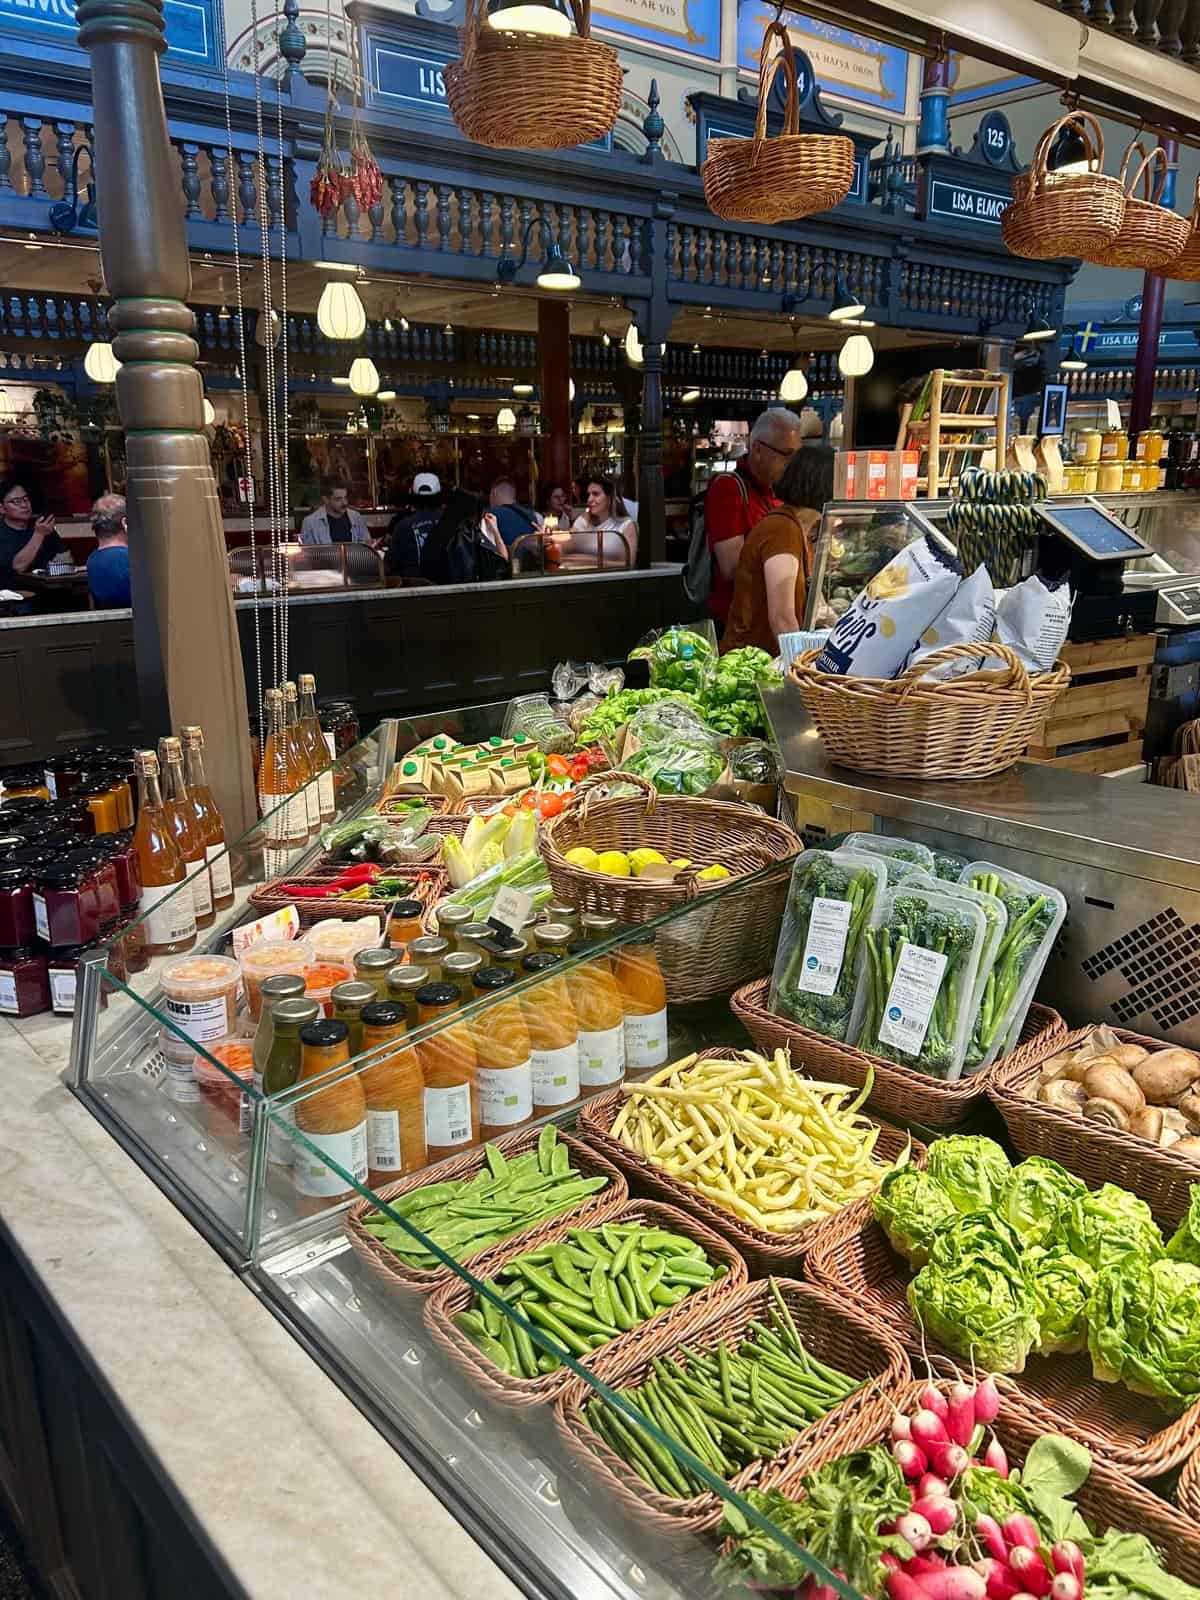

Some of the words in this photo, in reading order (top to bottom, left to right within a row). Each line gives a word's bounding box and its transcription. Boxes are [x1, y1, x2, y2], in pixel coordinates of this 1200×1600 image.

[420, 67, 446, 97] LIS
[987, 127, 1005, 148] 125
[952, 191, 974, 213] LISA
[1102, 335, 1121, 345] LISA
